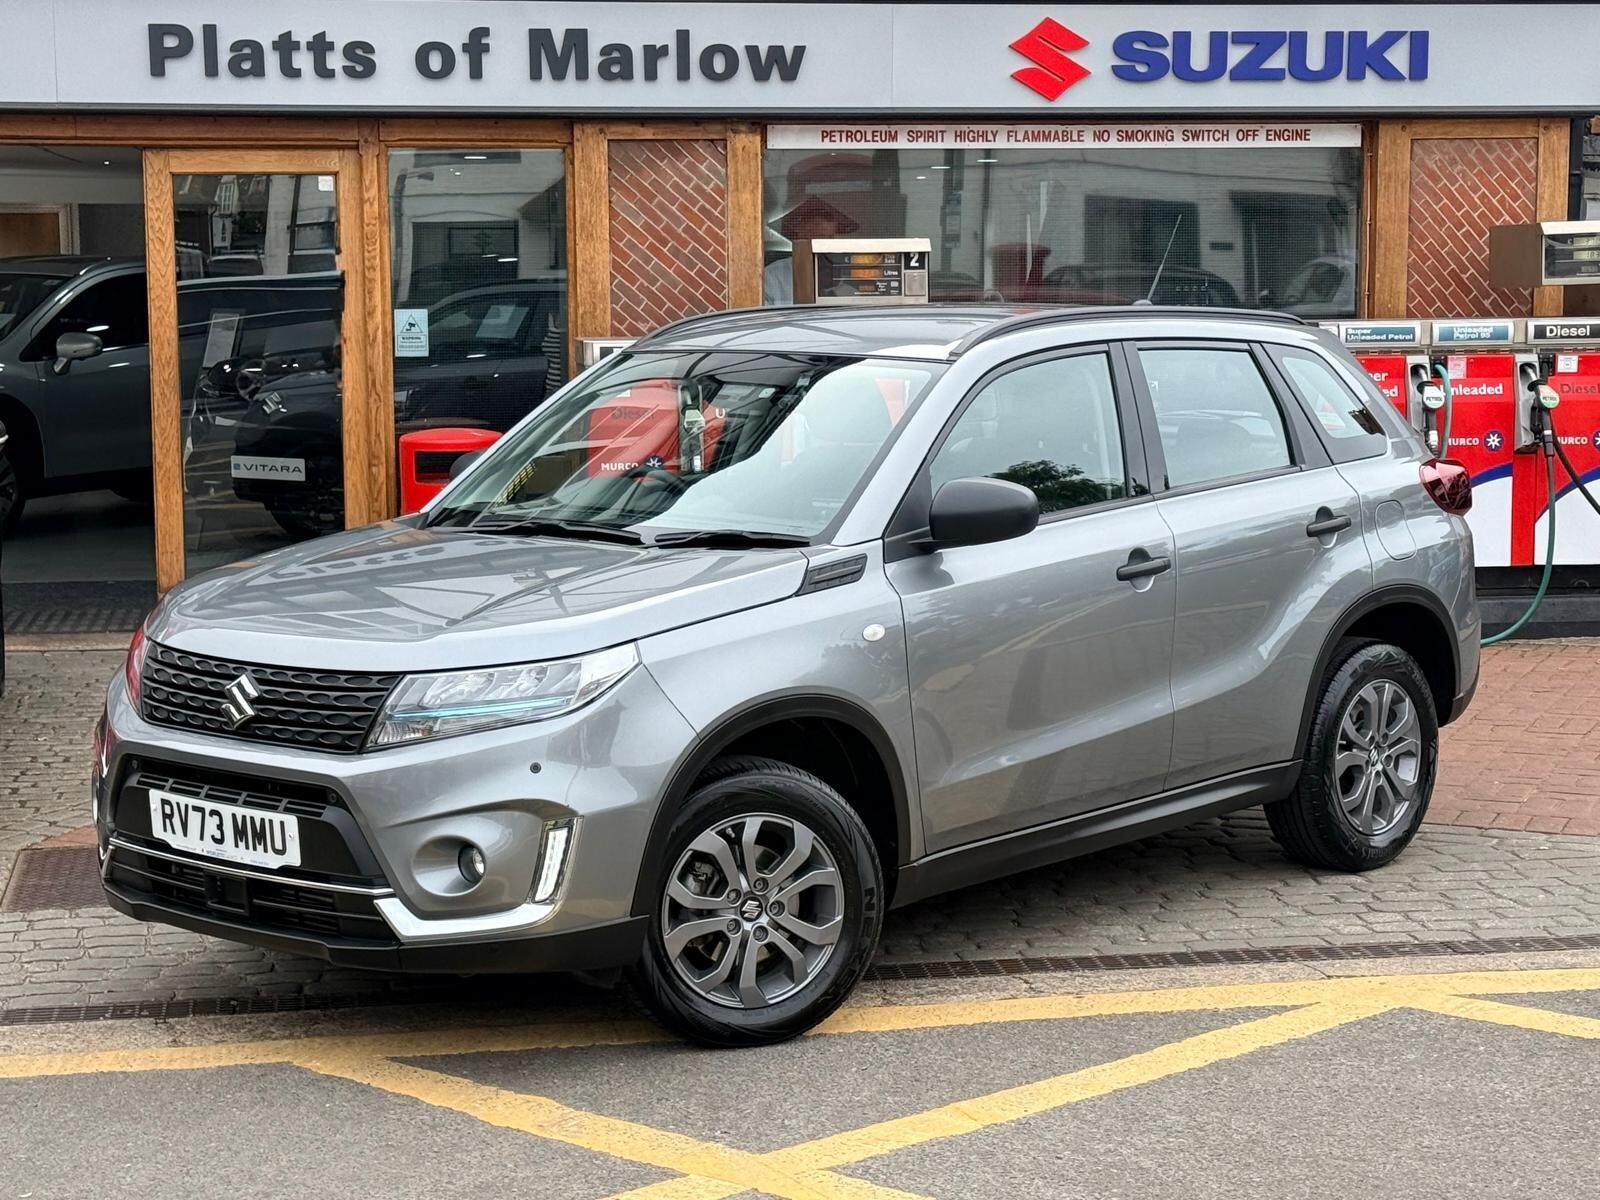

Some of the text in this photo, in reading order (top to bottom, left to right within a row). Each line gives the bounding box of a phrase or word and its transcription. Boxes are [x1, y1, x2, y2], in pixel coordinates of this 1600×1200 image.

[147, 23, 807, 83] Platts of Marlow
[1111, 30, 1429, 82] SUZUKI
[821, 128, 1311, 143] PETROLEUM SPIRIT HIGHLY FLAMMABLE NO SMOKING SWITCH OFF ENGINE
[909, 252, 919, 267] 2
[1347, 333, 1387, 341] Unleaded
[1453, 332, 1478, 340] Petrol
[1546, 325, 1590, 338] Diesel
[243, 463, 303, 473] VITARA
[160, 798, 288, 856] RV73 MMU
